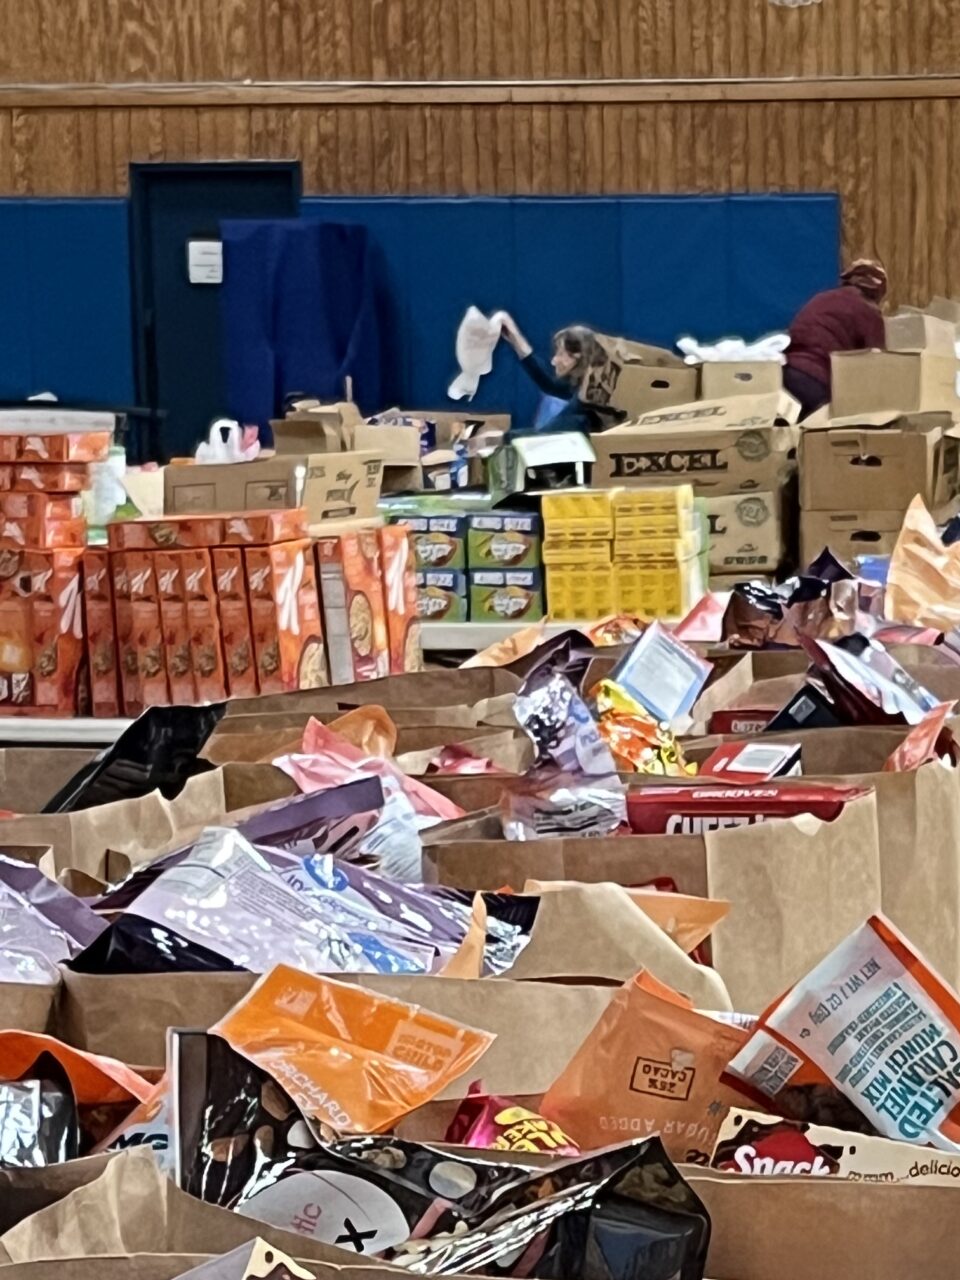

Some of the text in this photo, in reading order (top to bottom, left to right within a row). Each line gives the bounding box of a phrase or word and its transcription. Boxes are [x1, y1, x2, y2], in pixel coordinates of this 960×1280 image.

[609, 449, 728, 478] EXCEL
[642, 1064, 688, 1082] CACAO
[860, 1022, 943, 1107] MUNCH MIX
[876, 1039, 959, 1122] CARAMEL
[728, 1145, 830, 1175] Snack
